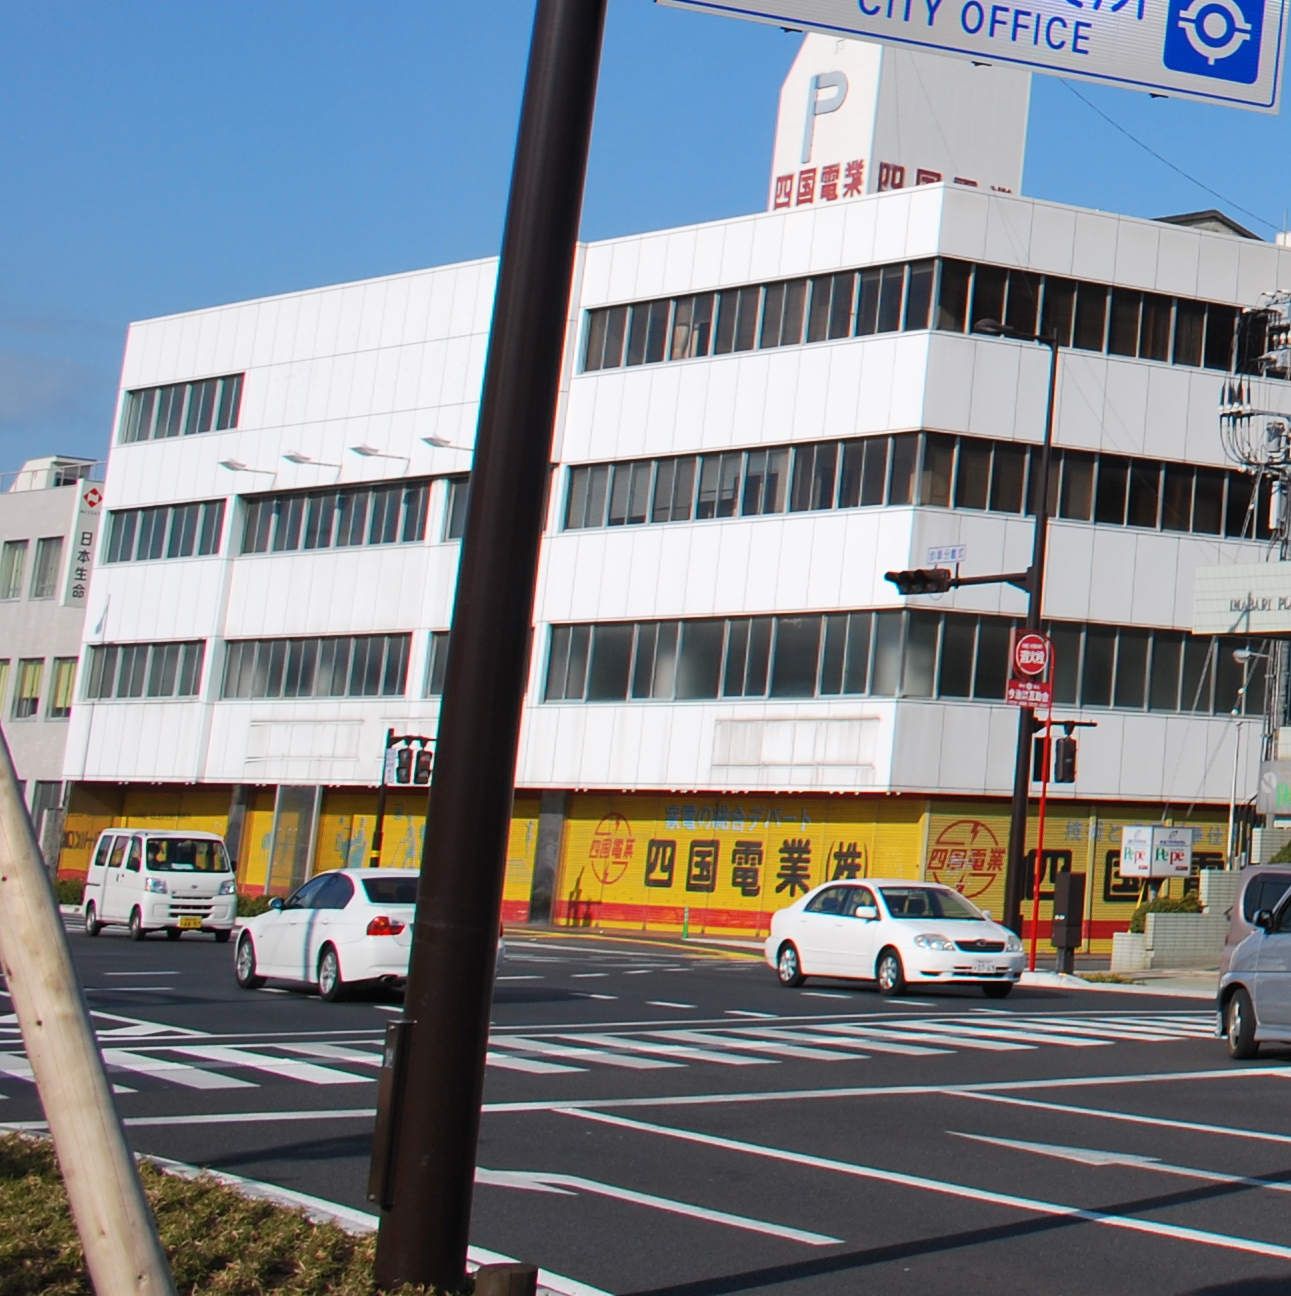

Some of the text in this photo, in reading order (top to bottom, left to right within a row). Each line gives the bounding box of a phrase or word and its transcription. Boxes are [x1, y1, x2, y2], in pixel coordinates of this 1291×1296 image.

[960, 1, 1093, 55] OFFICE
[801, 71, 848, 164] P
[774, 159, 865, 210] 四国電業
[72, 531, 93, 598] 日本生命
[1230, 598, 1272, 612] IMABARI
[927, 848, 1006, 872] 四国電業
[1155, 846, 1185, 865] Pepe
